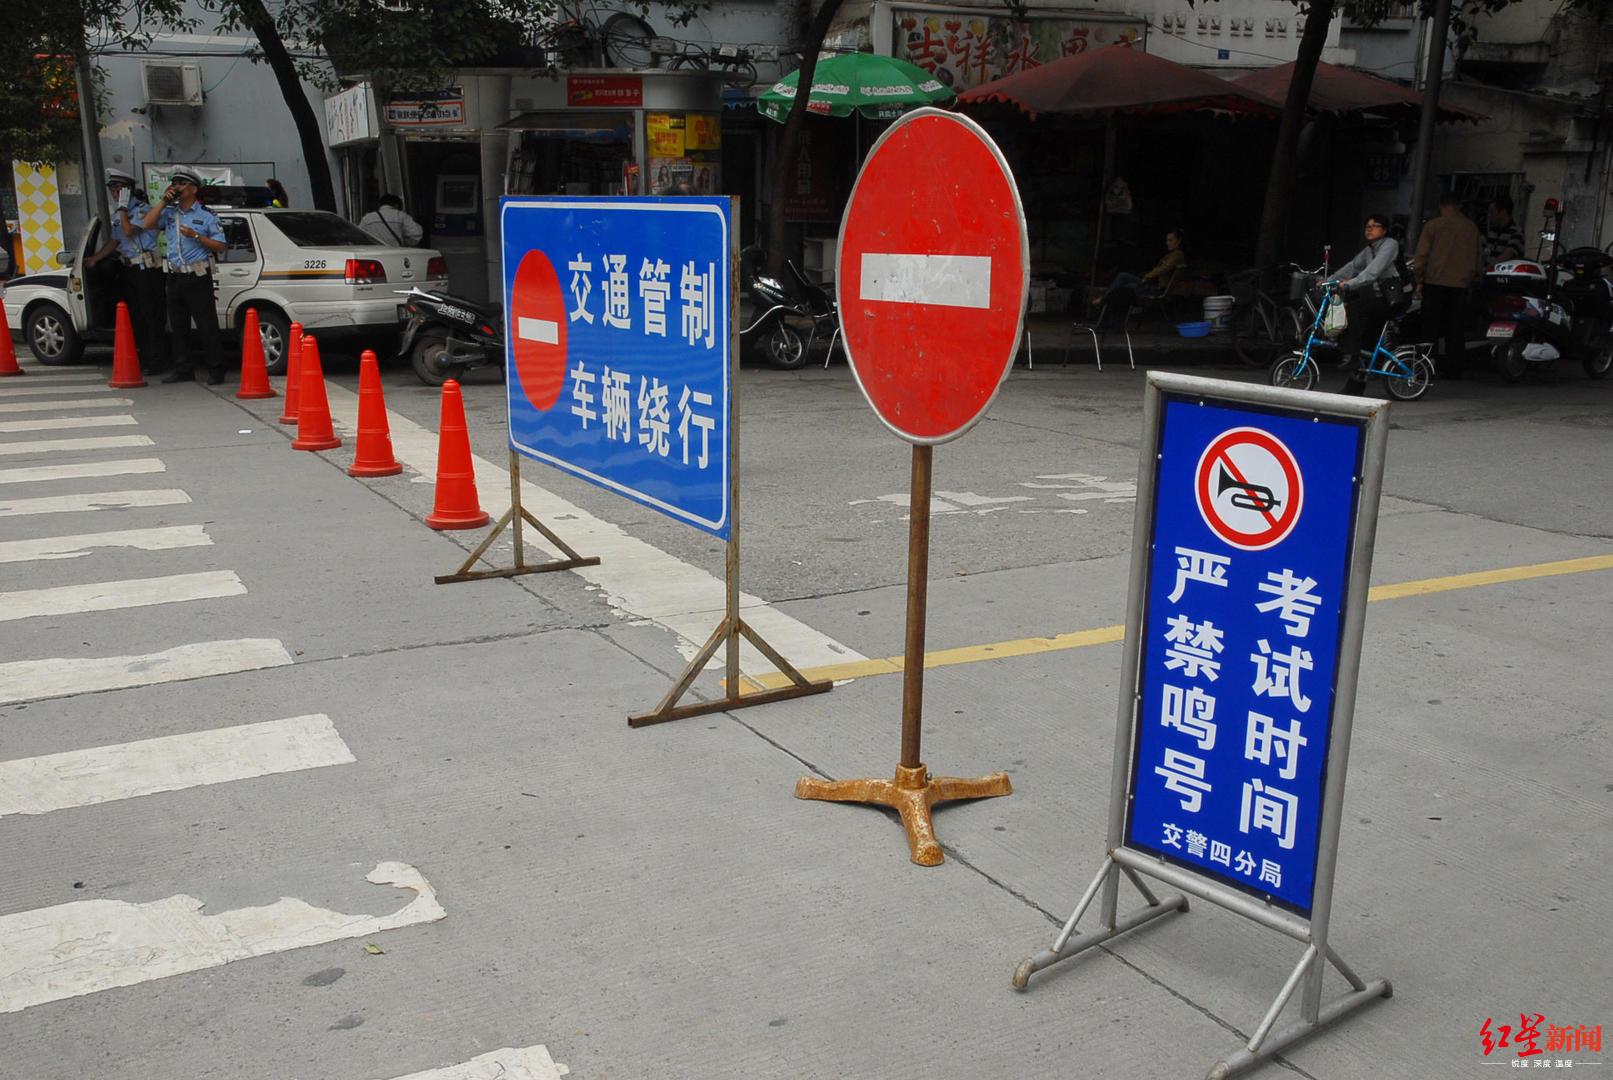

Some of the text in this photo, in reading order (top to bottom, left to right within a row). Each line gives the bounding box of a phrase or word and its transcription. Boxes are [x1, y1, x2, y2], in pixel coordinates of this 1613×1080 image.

[303, 259, 327, 270] 3226
[568, 252, 715, 349] 交通管制
[569, 361, 715, 470] 车辆绕行
[1154, 546, 1231, 813] 严禁鸣号
[1239, 568, 1322, 851] 考试时间
[1161, 821, 1282, 889] 交警四分局
